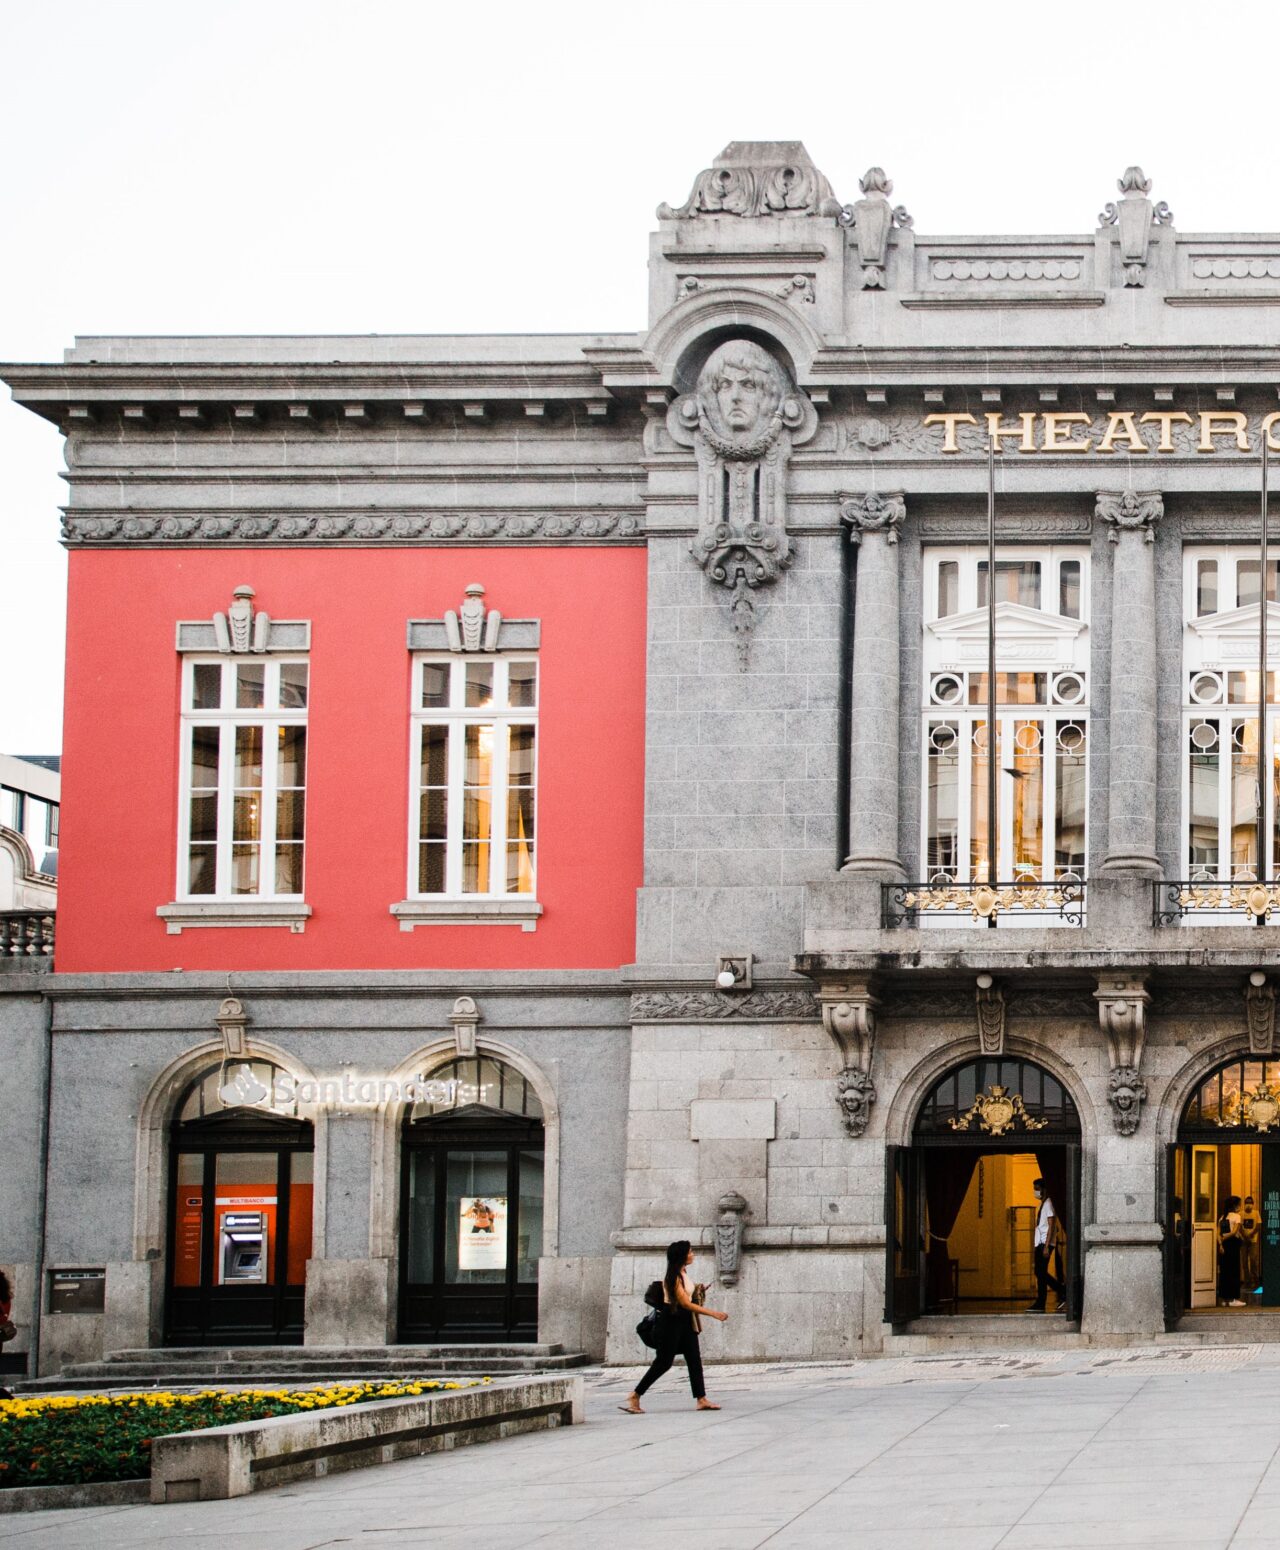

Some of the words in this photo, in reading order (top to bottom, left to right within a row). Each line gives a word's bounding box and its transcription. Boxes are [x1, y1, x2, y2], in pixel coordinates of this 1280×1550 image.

[274, 1073, 458, 1104] Santander
[1268, 1191, 1279, 1201] NÃO
[1268, 1210, 1279, 1218] POR
[1268, 1219, 1280, 1229] AQUI
